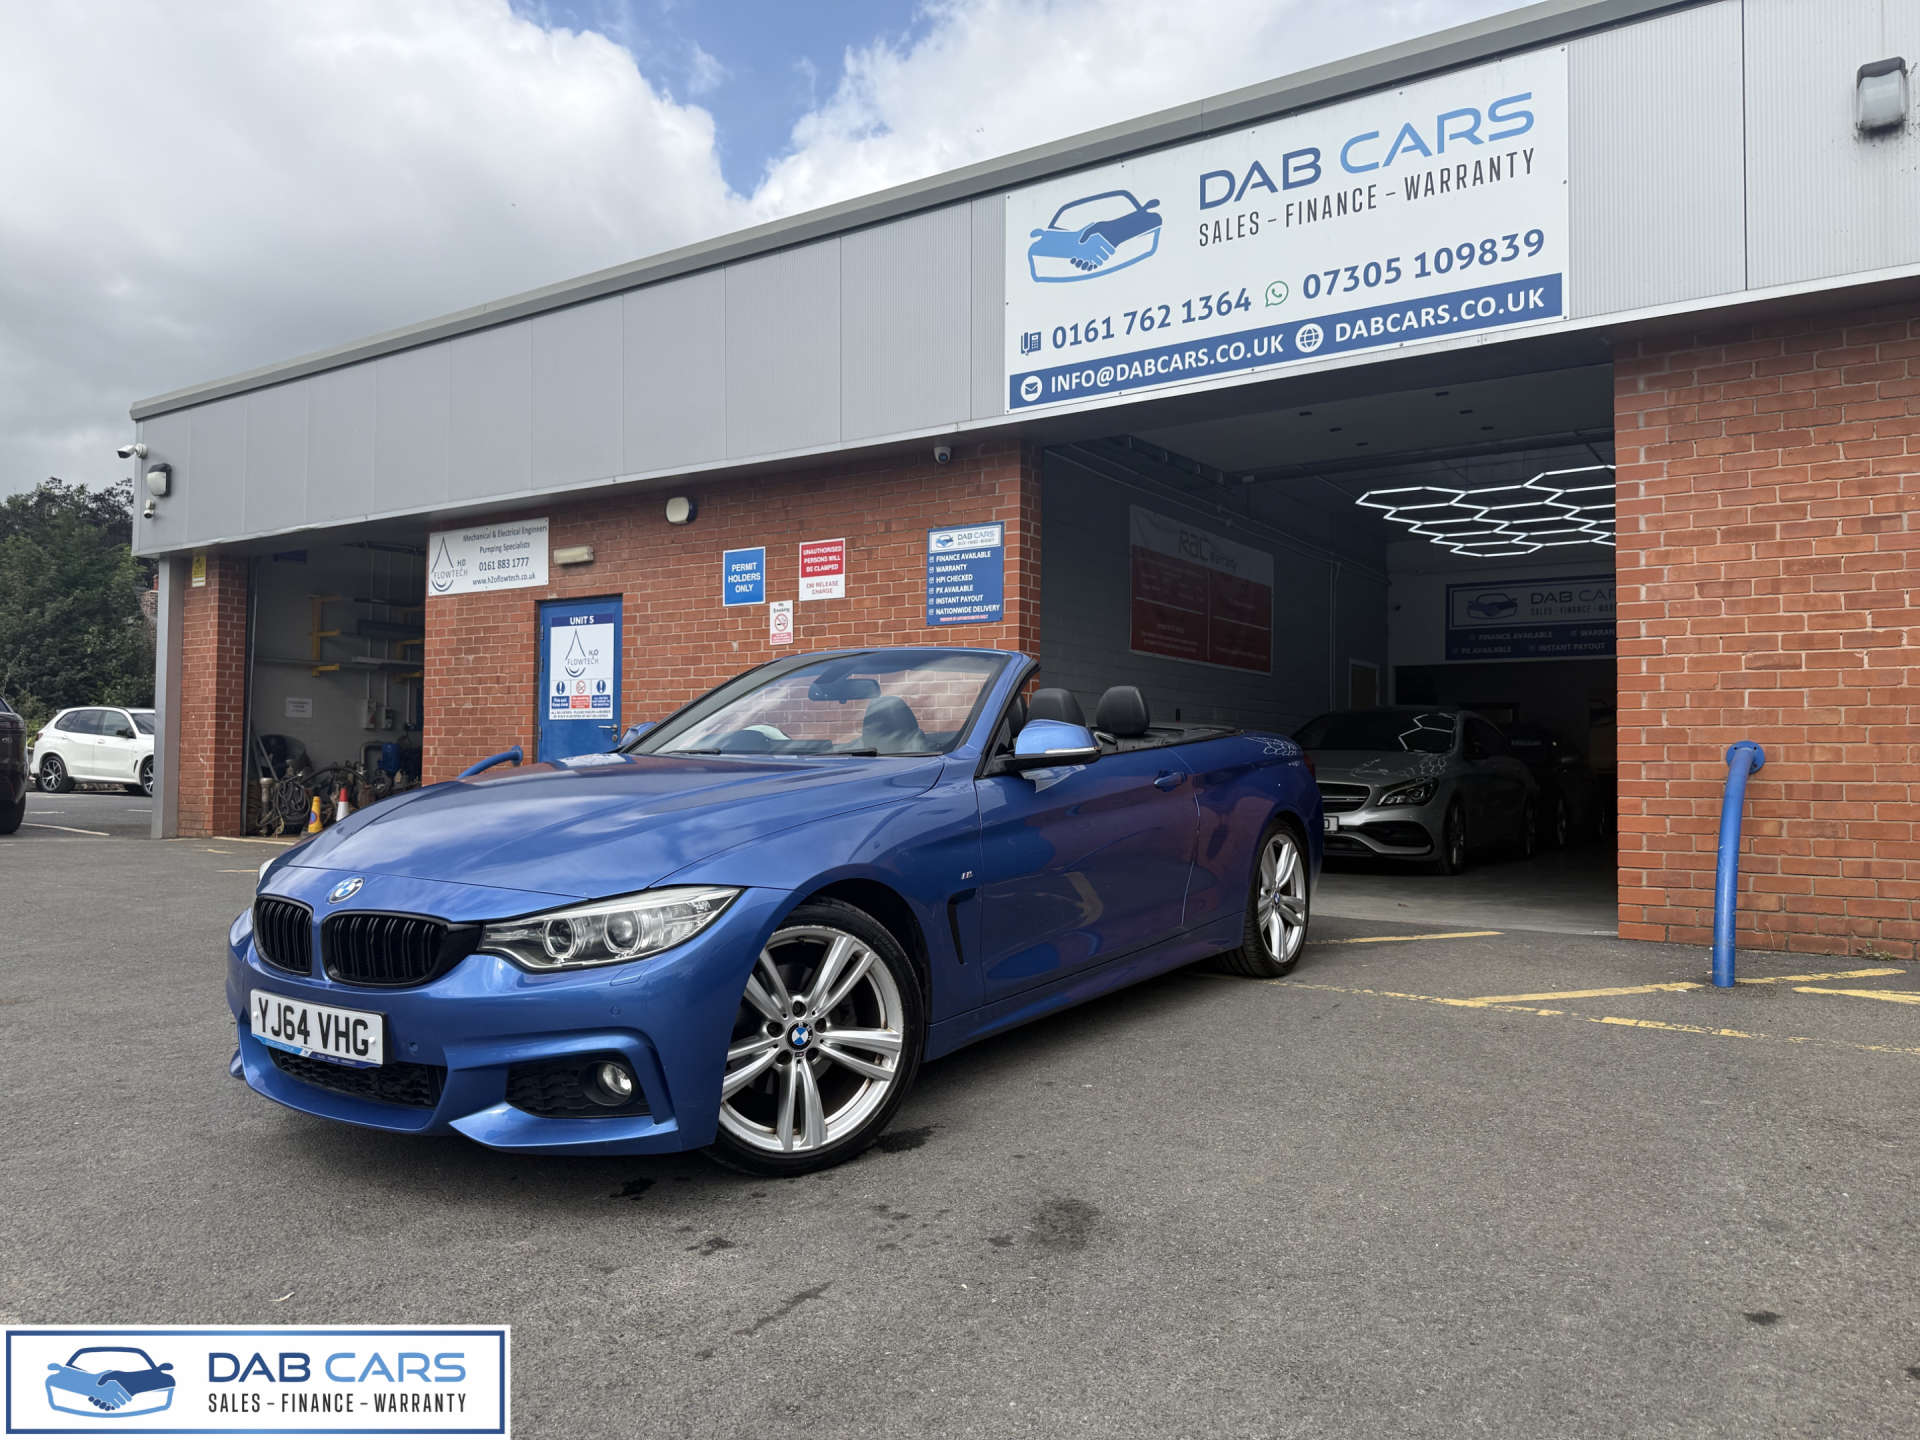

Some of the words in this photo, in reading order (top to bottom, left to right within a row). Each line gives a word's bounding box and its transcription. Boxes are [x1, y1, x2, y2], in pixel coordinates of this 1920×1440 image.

[1199, 147, 1322, 210] DAB
[1340, 91, 1534, 174] CARS
[1199, 211, 1259, 247] SALES
[1286, 184, 1377, 228] FINANCE
[1405, 147, 1534, 201] WARRANTY
[1302, 257, 1402, 299] 07305
[1414, 228, 1545, 279] 109839
[1052, 316, 1115, 349] 0161
[1123, 304, 1171, 335] 762
[1181, 287, 1252, 324] 1364
[1335, 287, 1545, 342] DABCARS.CO.UK
[1051, 334, 1284, 393] INFO@DABCARS.CO.UK
[463, 531, 491, 542] Mechanical
[497, 528, 521, 538] Electrical
[521, 525, 547, 536] Engineers
[480, 544, 502, 554] Pumping
[503, 542, 530, 551] Specialists
[936, 553, 960, 563] FINANCE
[961, 551, 991, 560] AVAILABLE
[479, 561, 496, 572] 0161
[497, 559, 510, 570] 883
[512, 557, 530, 568] 1777
[732, 562, 758, 572] PERMIT
[936, 564, 967, 573] WARRANTY
[434, 569, 468, 580] FLOWTECH
[728, 572, 761, 583] HOLDERS
[947, 574, 973, 583] CHECKED
[735, 584, 754, 593] ONLY
[944, 584, 974, 593] AVAILABLE
[936, 596, 959, 605] INSTANT
[960, 594, 983, 603] PAYOUT
[936, 606, 972, 615] NATIONWIDE
[972, 604, 1000, 613] DELIVERY
[570, 616, 588, 625] UNIT
[589, 615, 595, 624] 5
[258, 996, 310, 1046] YJ64
[317, 1011, 369, 1056] VHG
